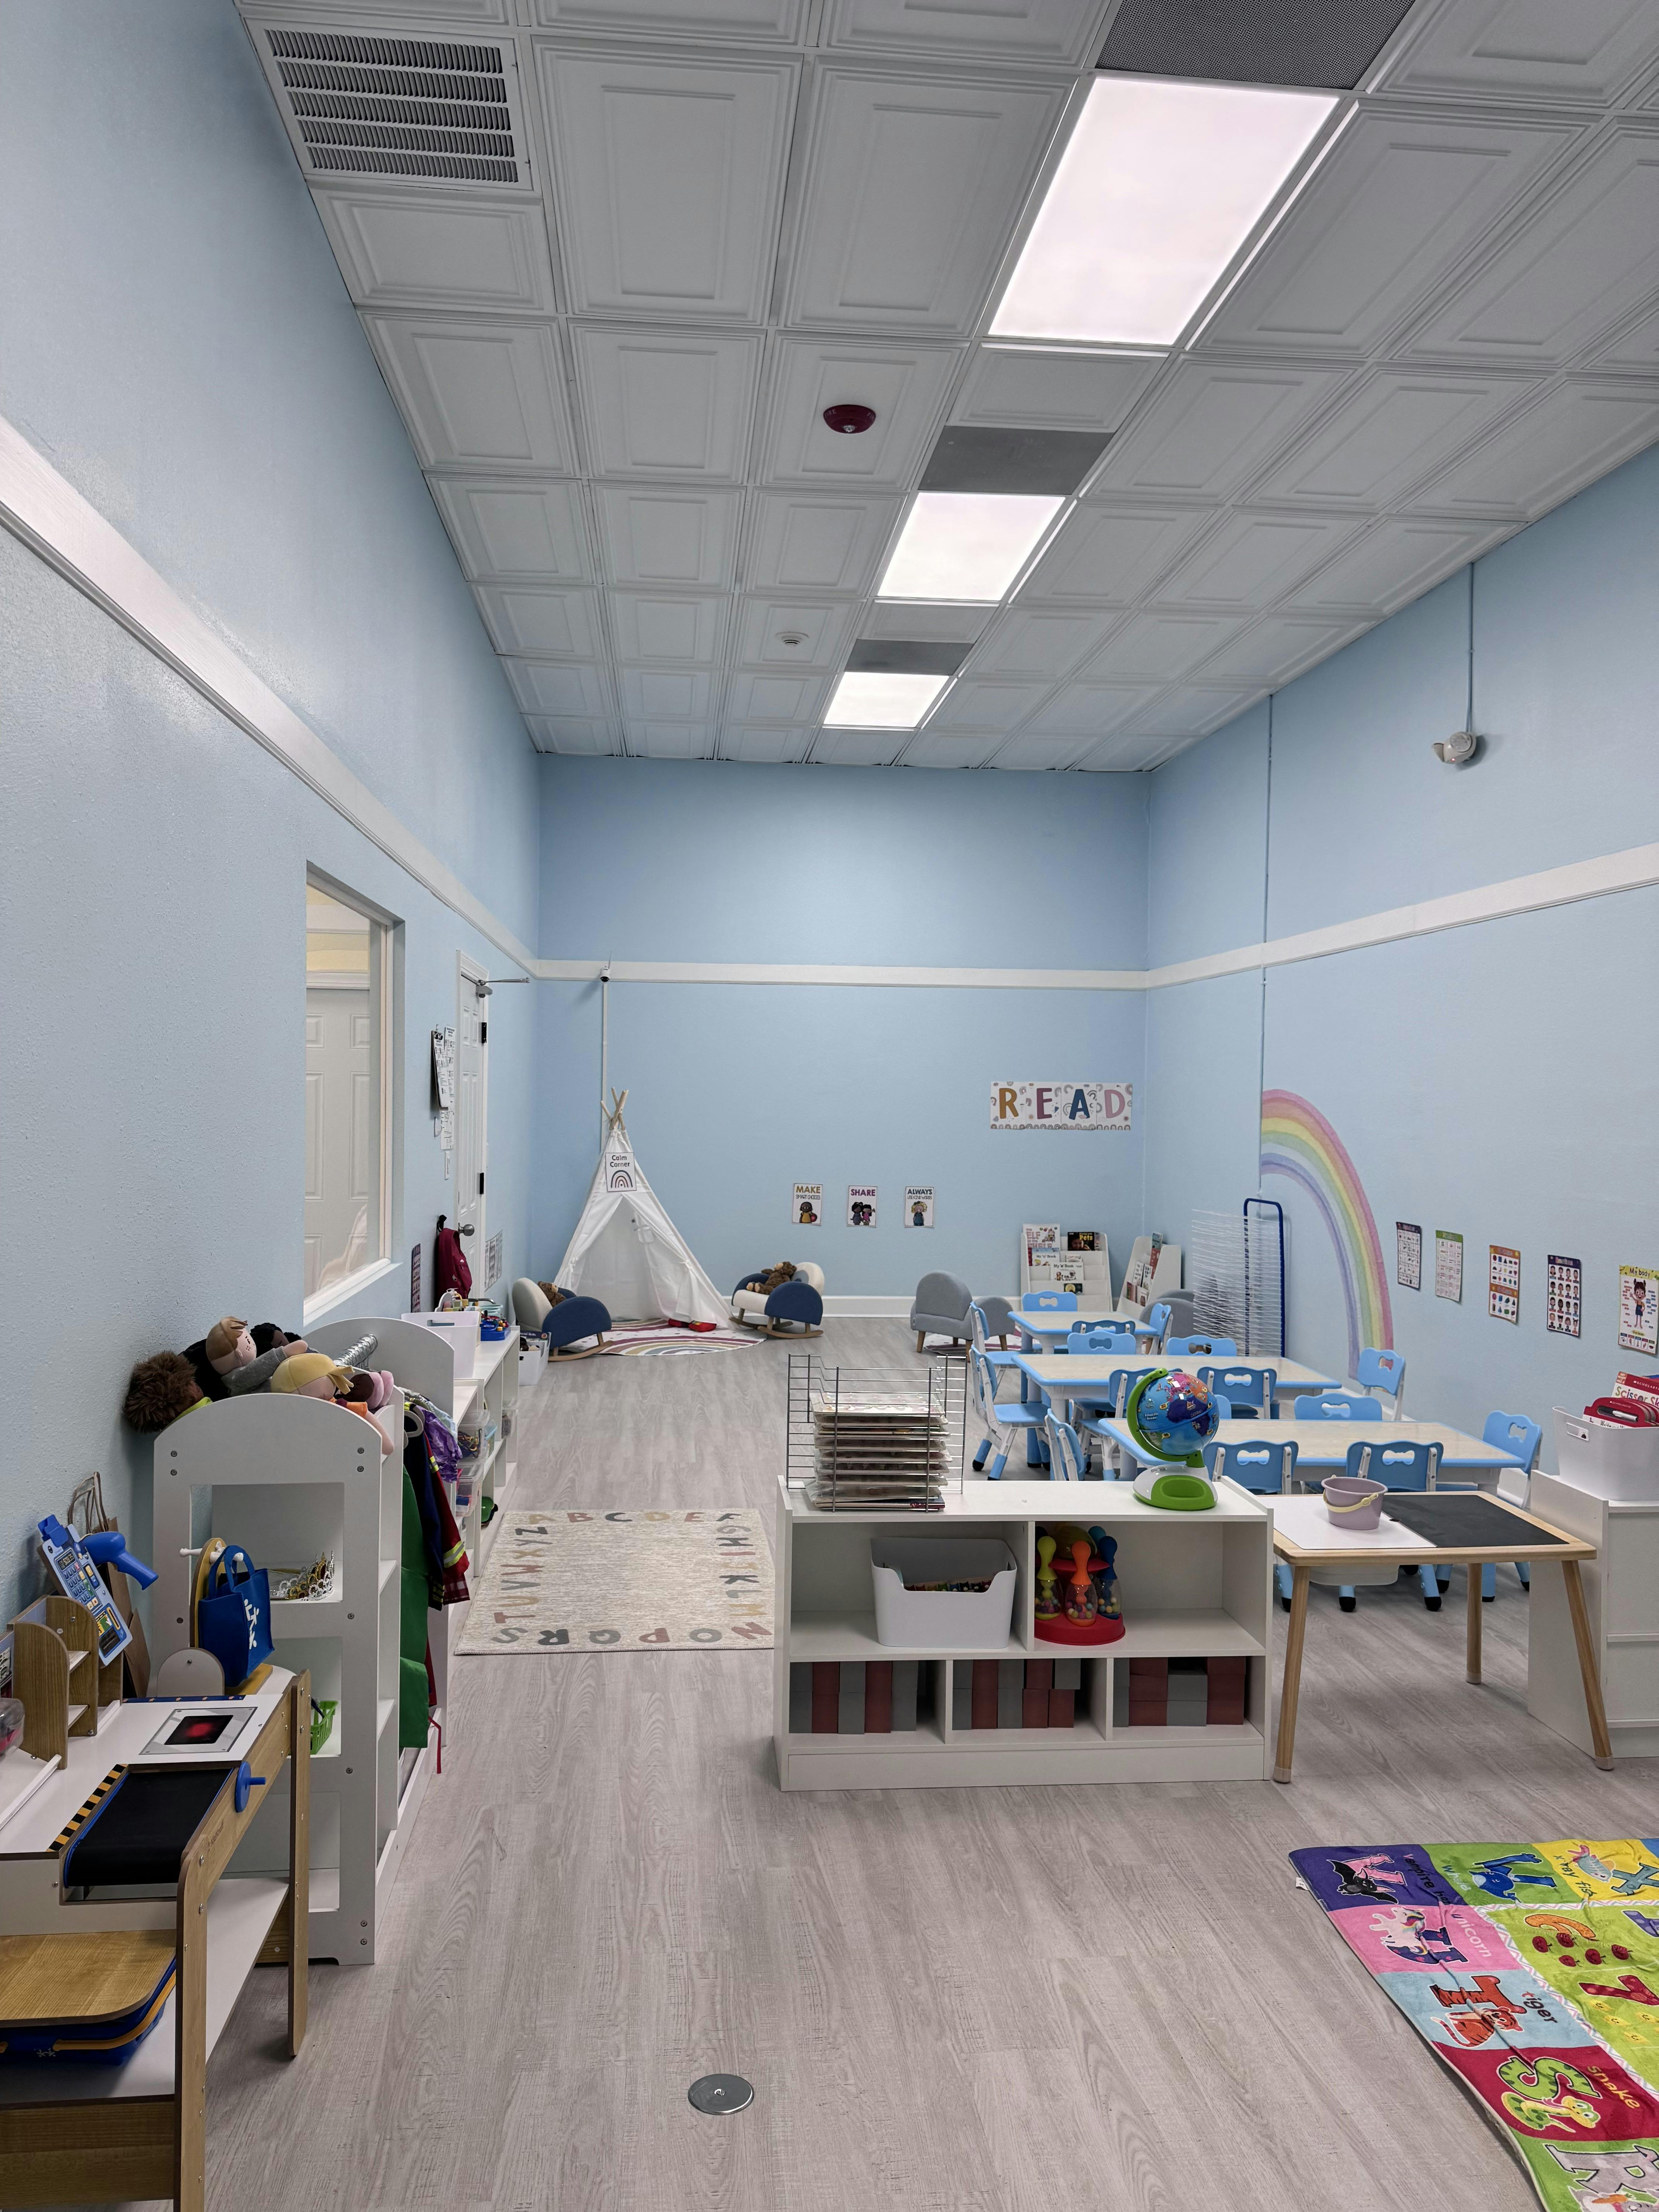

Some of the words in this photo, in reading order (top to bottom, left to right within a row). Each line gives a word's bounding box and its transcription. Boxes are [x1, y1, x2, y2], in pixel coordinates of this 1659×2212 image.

[999, 1088, 1125, 1120] READ
[1630, 1267, 1637, 1276] My
[1638, 1269, 1650, 1277] body
[1637, 1381, 1659, 1390] SCHOLASTI
[528, 1514, 555, 1524] A
[567, 1512, 594, 1522] B
[605, 1512, 633, 1522] C
[644, 1511, 670, 1521] D
[684, 1512, 704, 1522] E
[716, 1513, 742, 1522] F
[515, 1527, 548, 1535] Z
[717, 1525, 751, 1534] G
[716, 1537, 754, 1546] H
[512, 1549, 545, 1559] X
[501, 1564, 545, 1575] W
[501, 1580, 541, 1590] V
[719, 1575, 760, 1584] K
[726, 1590, 763, 1598] L
[498, 1595, 539, 1607] U
[729, 1603, 768, 1616] M
[494, 1612, 536, 1623] T
[490, 1627, 528, 1644] S
[538, 1629, 569, 1645] R
[588, 1629, 621, 1644] Q
[639, 1627, 670, 1644] P
[689, 1628, 722, 1643] O
[732, 1622, 773, 1640] N
[1451, 1914, 1492, 1958] unicorn
[1430, 1975, 1528, 2014] T
[1522, 1991, 1558, 2023] tiger
[1498, 2057, 1602, 2101] S
[1587, 2066, 1640, 2110] snake
